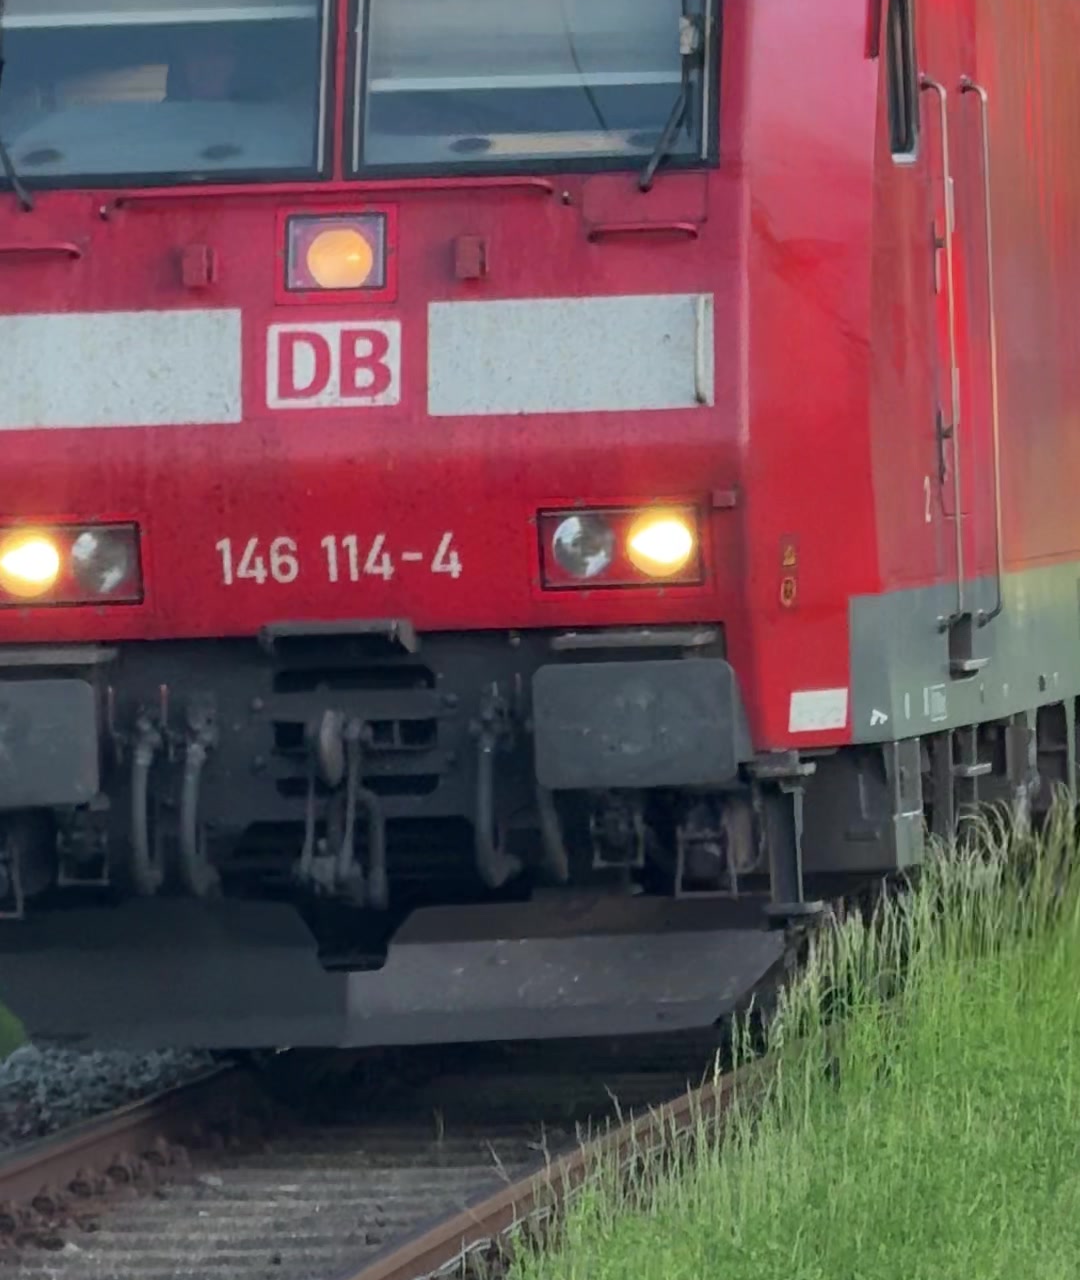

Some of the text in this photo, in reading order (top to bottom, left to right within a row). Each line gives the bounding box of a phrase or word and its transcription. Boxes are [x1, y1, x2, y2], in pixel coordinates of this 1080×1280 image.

[277, 328, 392, 401] DB
[215, 531, 463, 585] 146 114-4
